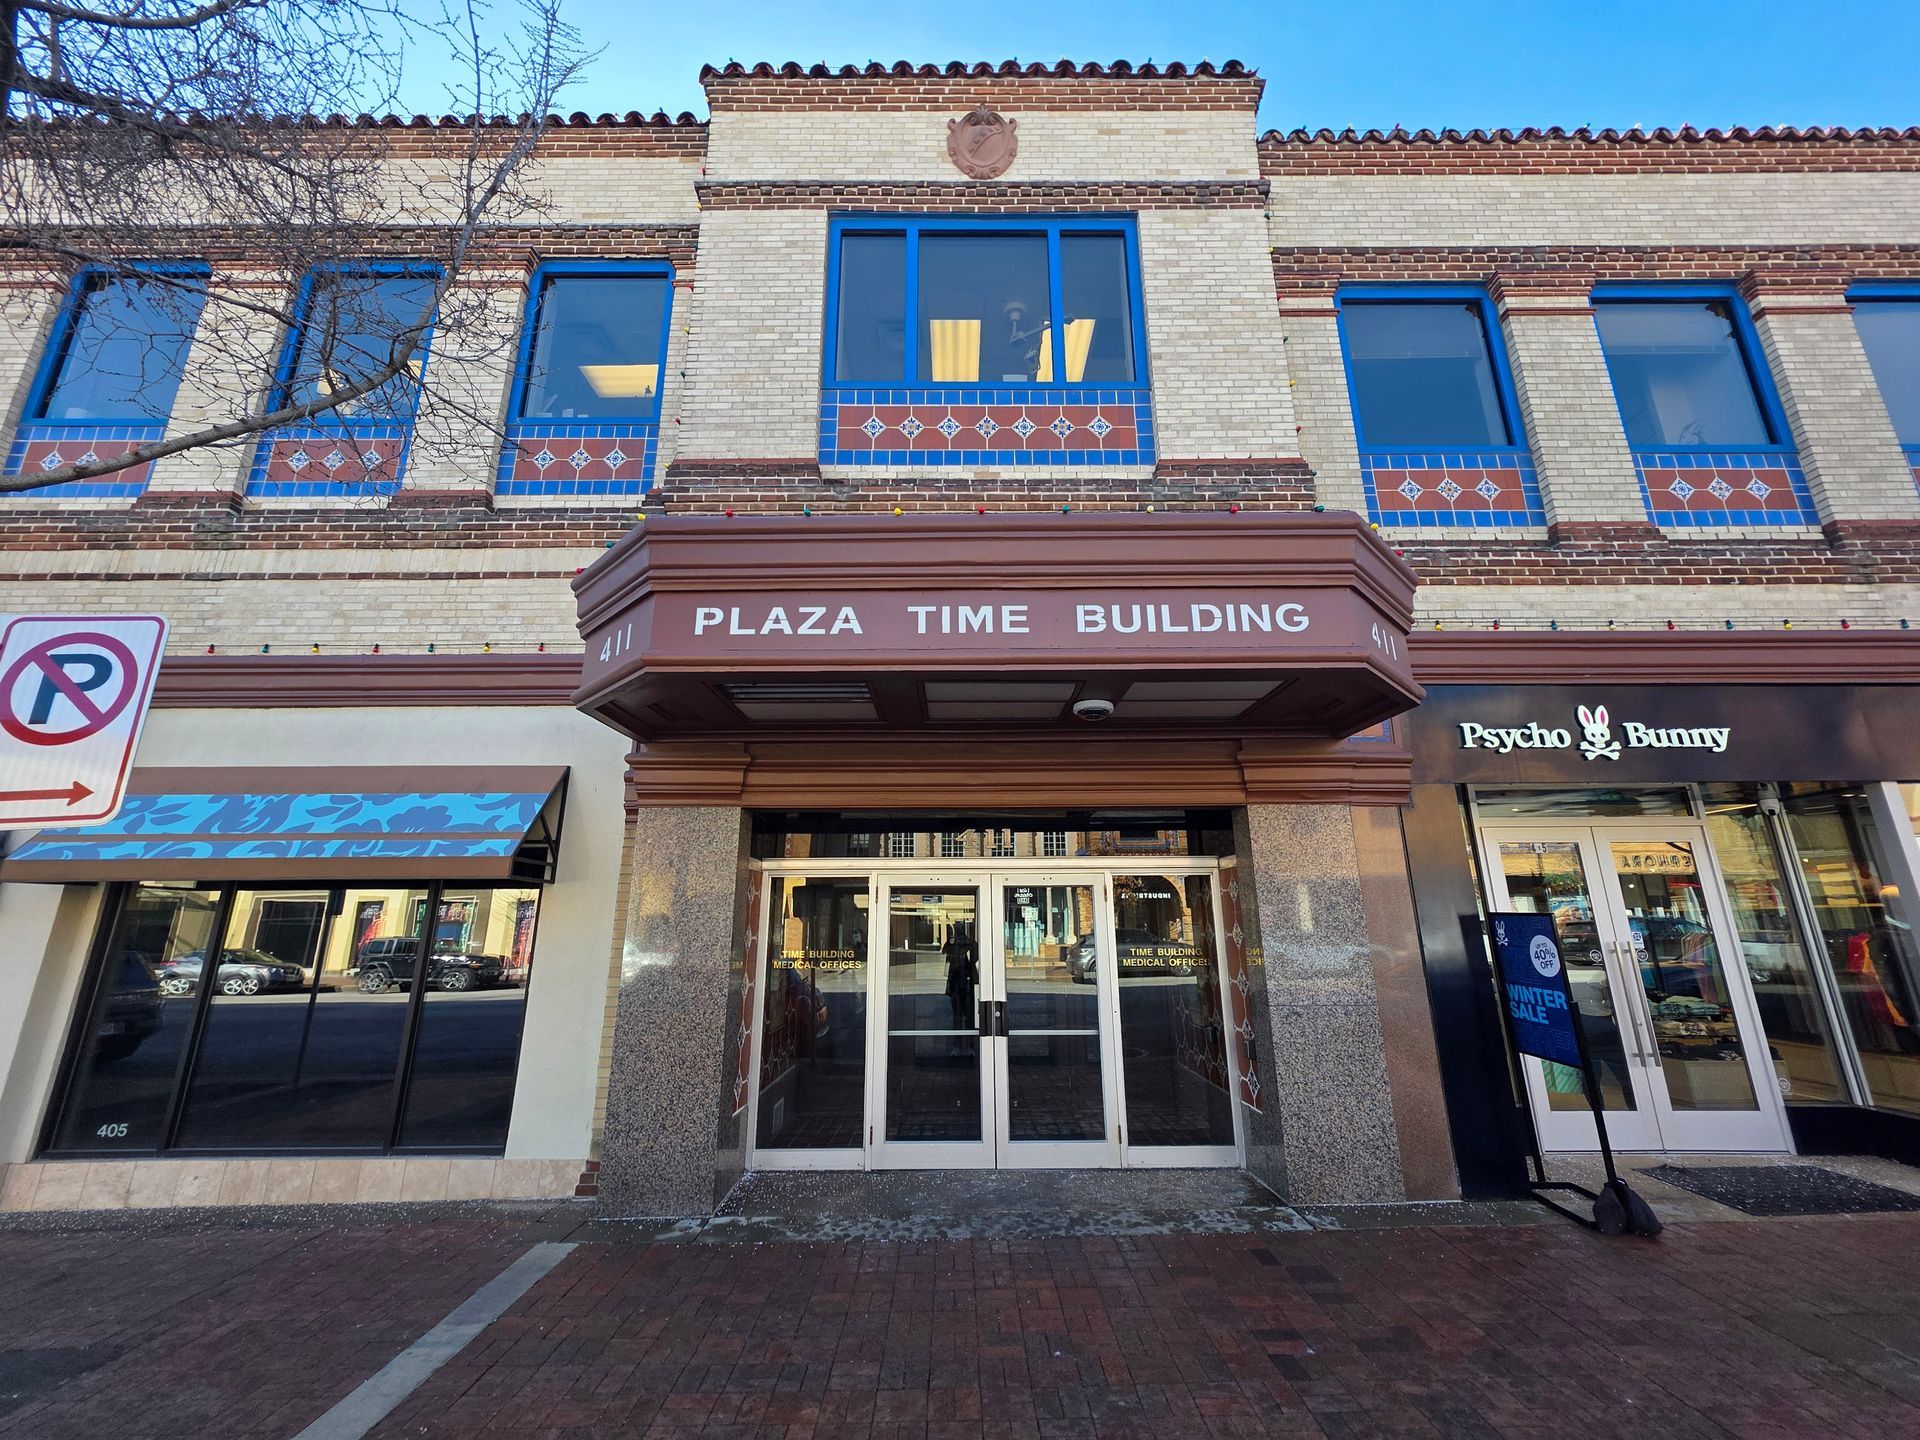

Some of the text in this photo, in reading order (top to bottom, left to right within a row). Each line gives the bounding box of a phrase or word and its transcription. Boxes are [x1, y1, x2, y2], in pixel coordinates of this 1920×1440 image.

[694, 603, 1310, 636] PLAZA TIME BUILDING
[600, 623, 632, 662] 411
[1372, 622, 1397, 660] 411
[1459, 721, 1731, 753] Psycho Bunny
[955, 828, 1013, 849] 411
[782, 950, 855, 959] TIME BUILDING
[1130, 948, 1203, 956] TIME BUILDING
[1534, 949, 1556, 961] 40%
[772, 960, 862, 969] MEDICAL OFFICES
[1123, 958, 1211, 967] MEDICAL OFFICES
[1540, 961, 1554, 970] OFF
[1506, 983, 1568, 1010] WINTER
[1510, 1001, 1549, 1024] SALE
[97, 1123, 128, 1137] 405
